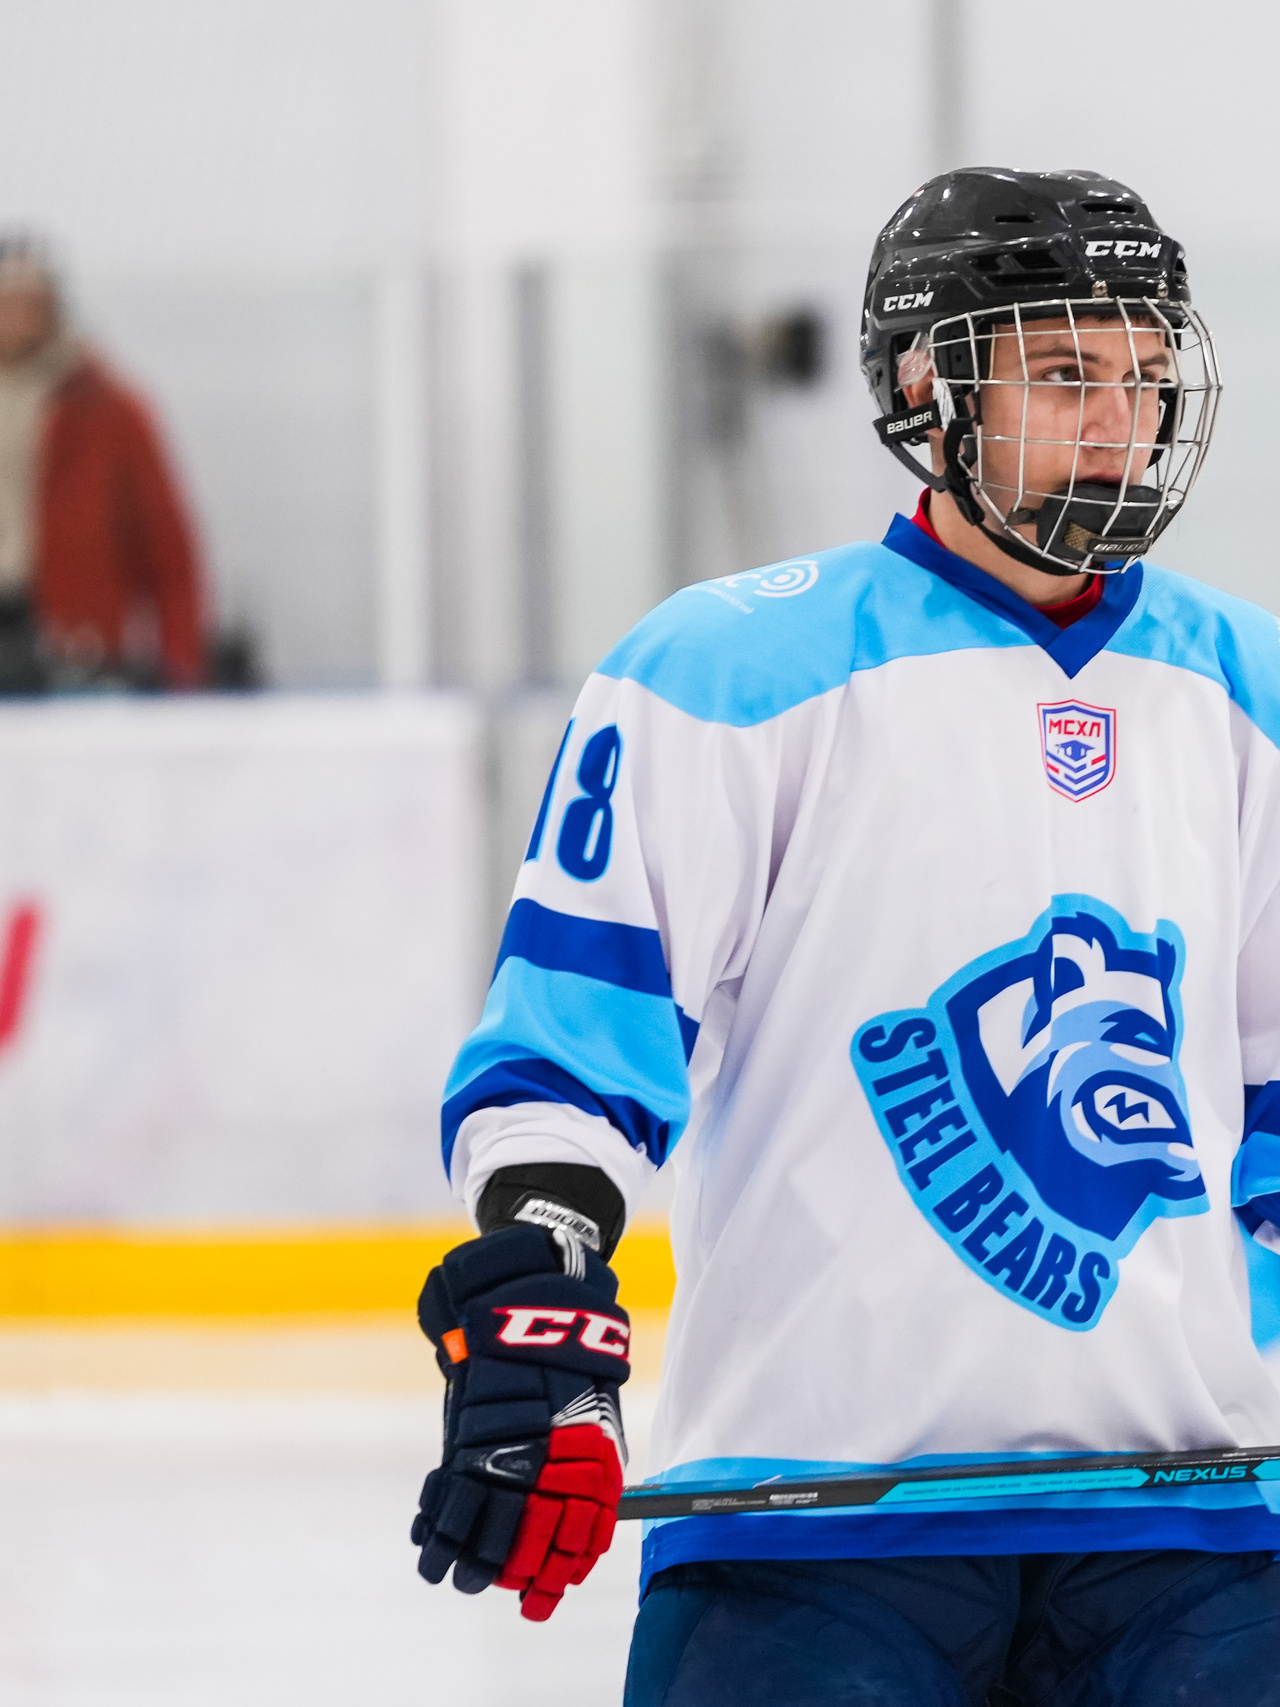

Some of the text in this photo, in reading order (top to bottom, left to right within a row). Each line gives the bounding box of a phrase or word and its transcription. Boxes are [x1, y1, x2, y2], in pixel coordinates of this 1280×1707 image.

[1085, 240, 1162, 259] CCM
[883, 291, 934, 312] CCM
[886, 410, 933, 434] BAUER
[1048, 718, 1102, 738] МСХЛ
[858, 1016, 978, 1191] STEEL
[932, 1162, 1111, 1324] BEARS
[491, 1305, 630, 1360] CC
[1153, 1465, 1248, 1484] NEXUS
